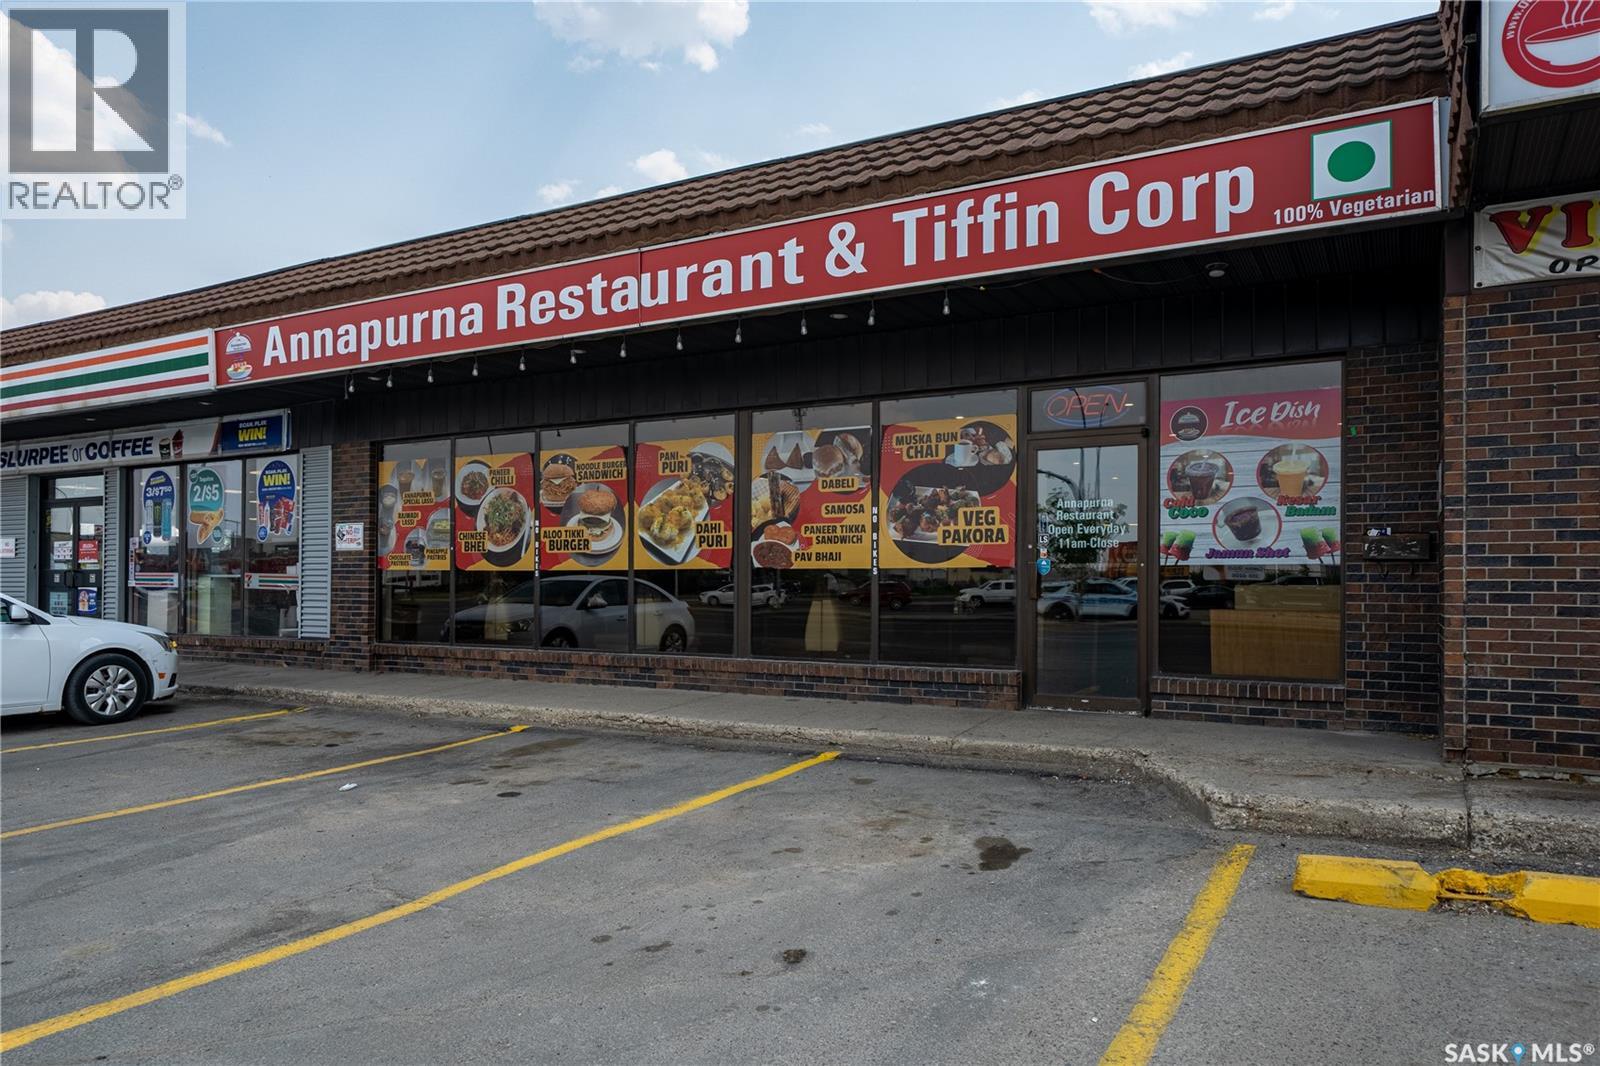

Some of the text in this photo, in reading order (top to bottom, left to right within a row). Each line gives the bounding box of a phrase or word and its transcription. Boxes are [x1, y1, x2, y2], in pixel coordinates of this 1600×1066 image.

[1273, 189, 1435, 225] 100% Vegetarian
[1489, 200, 1600, 255] VI
[263, 166, 1255, 367] Annapurna Restaurant & Tiffin Corp
[1047, 392, 1128, 417] OPEN
[1219, 400, 1321, 428] Ice Dish
[238, 427, 267, 442] WIN!
[895, 431, 958, 446] MUSKA BUN
[0, 436, 154, 468] SLURPEE or COFFEE
[659, 451, 679, 461] PANI
[906, 444, 939, 459] CHAI
[576, 463, 601, 471] NOODLE
[662, 460, 688, 473] PURI
[263, 472, 291, 487] WIN!
[490, 475, 514, 486] CHILLI
[577, 468, 623, 481] SANDWICH
[821, 478, 855, 490] DABELI
[193, 484, 220, 503] 2/$5
[824, 503, 865, 515] SAMOSA
[1056, 498, 1114, 510] Annapurna
[962, 509, 996, 526] VEG
[1056, 510, 1115, 521] Restaurant
[1168, 506, 1209, 520] Coco
[543, 529, 585, 539] ALOO TIKKI
[696, 523, 721, 534] DAHI
[803, 524, 867, 535] PANEER TIKKA
[1047, 523, 1126, 537] Open Everyday
[459, 531, 487, 541] CHINESE
[698, 534, 728, 548] PURI
[815, 535, 863, 545] SANDWICH
[942, 527, 1006, 544] PAKORA
[464, 540, 487, 552] BHEL
[548, 538, 590, 551] BURGER
[1058, 537, 1120, 549] 11am-Close
[794, 551, 842, 562] PAV BHAJI
